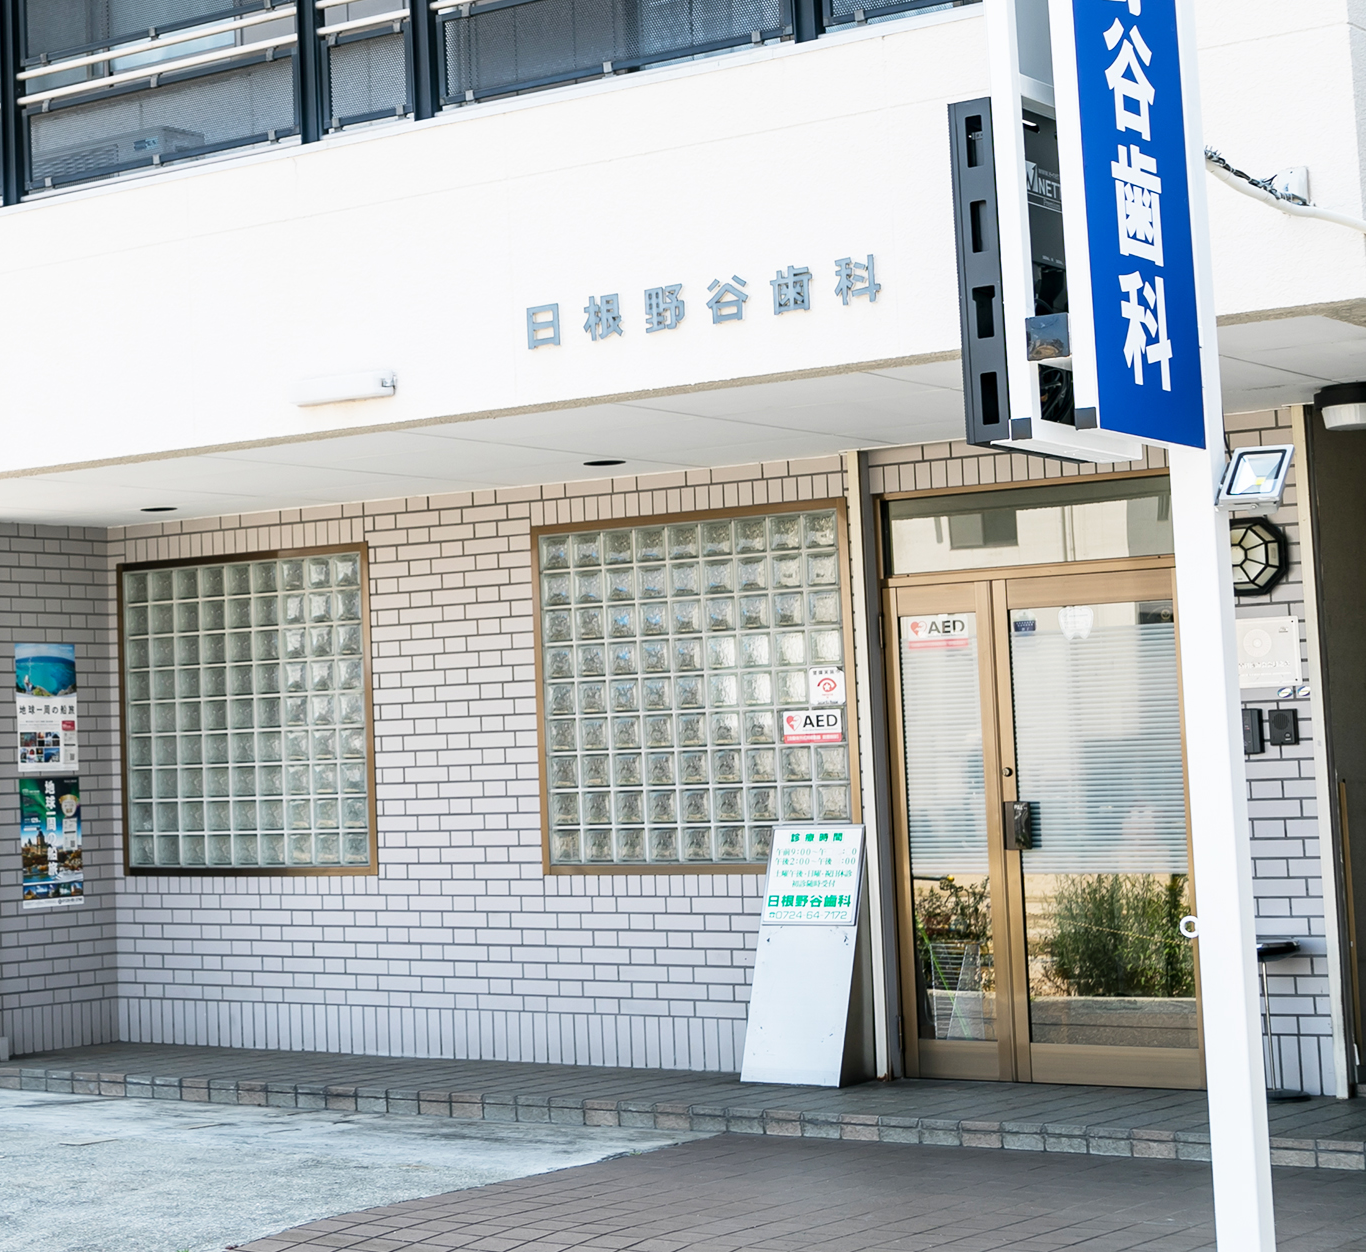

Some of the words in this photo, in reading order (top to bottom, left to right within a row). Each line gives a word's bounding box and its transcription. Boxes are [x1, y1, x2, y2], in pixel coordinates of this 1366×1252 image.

[1101, 0, 1173, 391] 谷歯科
[526, 254, 882, 349] 日根野谷歯科
[928, 620, 965, 634] AED
[19, 704, 75, 715] 地球一周の船旅
[803, 714, 838, 728] AED
[790, 833, 843, 842] 診療時間
[768, 895, 851, 908] 日根野谷歯科
